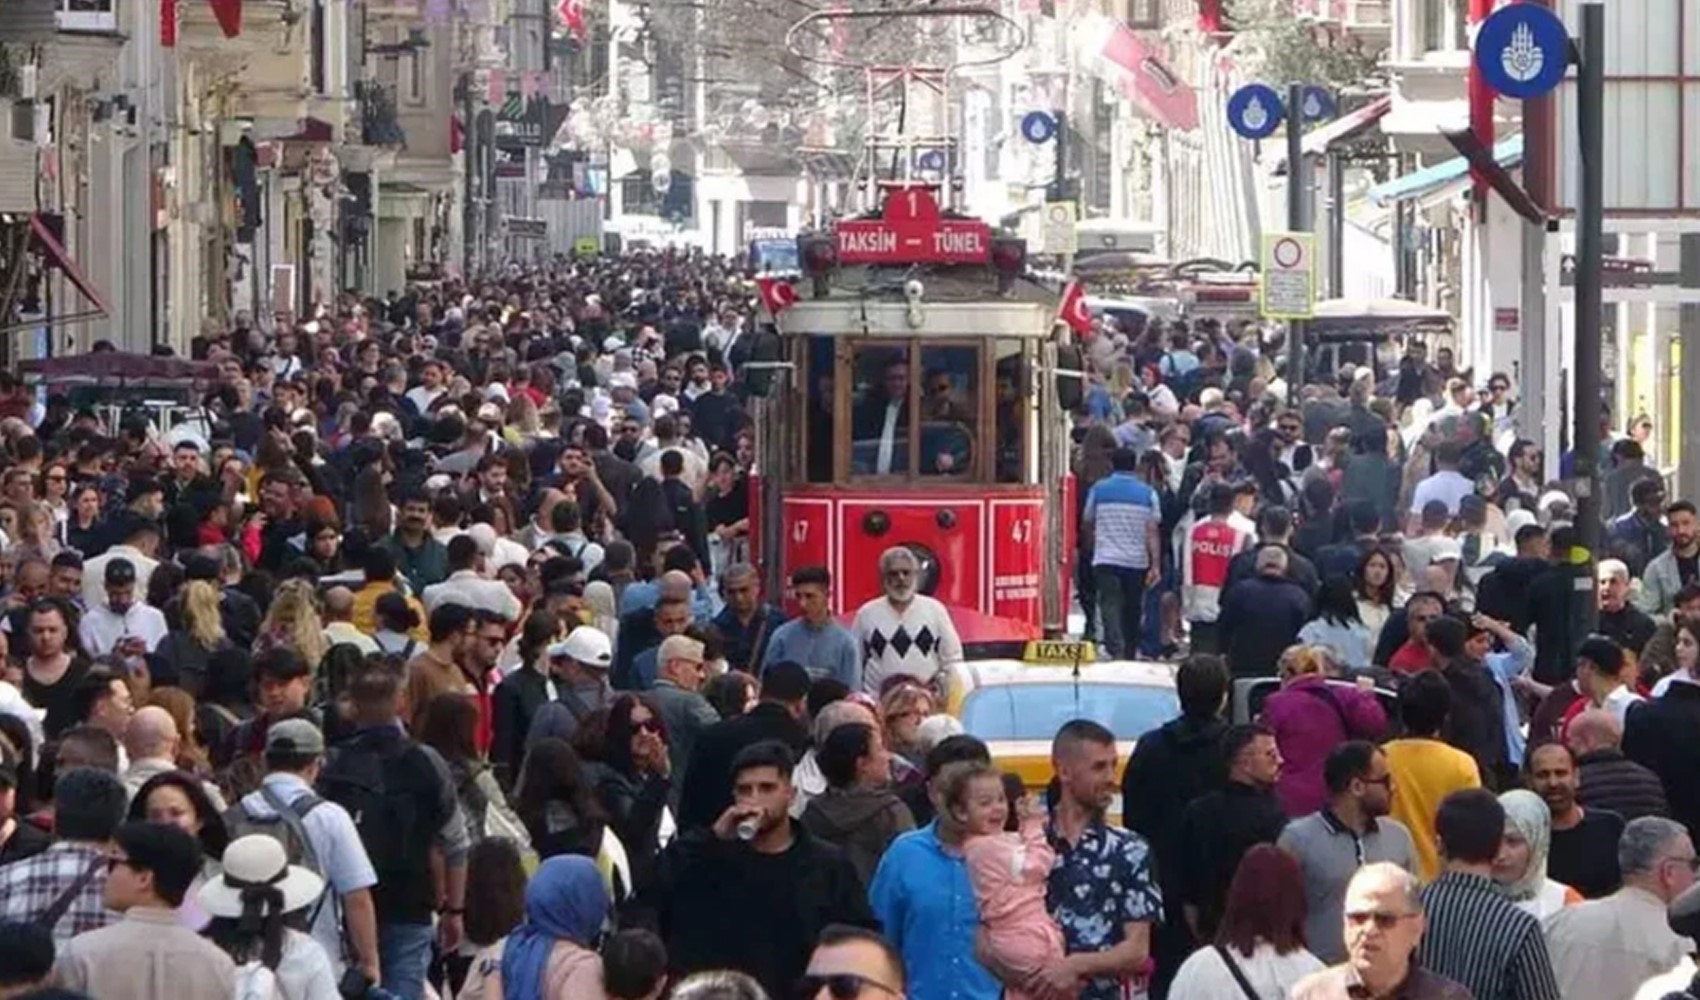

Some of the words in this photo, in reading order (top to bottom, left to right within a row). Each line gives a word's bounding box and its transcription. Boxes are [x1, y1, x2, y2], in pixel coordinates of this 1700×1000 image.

[908, 193, 917, 217] 1
[839, 227, 897, 252] TAKSİM
[933, 227, 984, 253] TÜNEL
[793, 520, 808, 542] 47
[1012, 519, 1032, 543] 47
